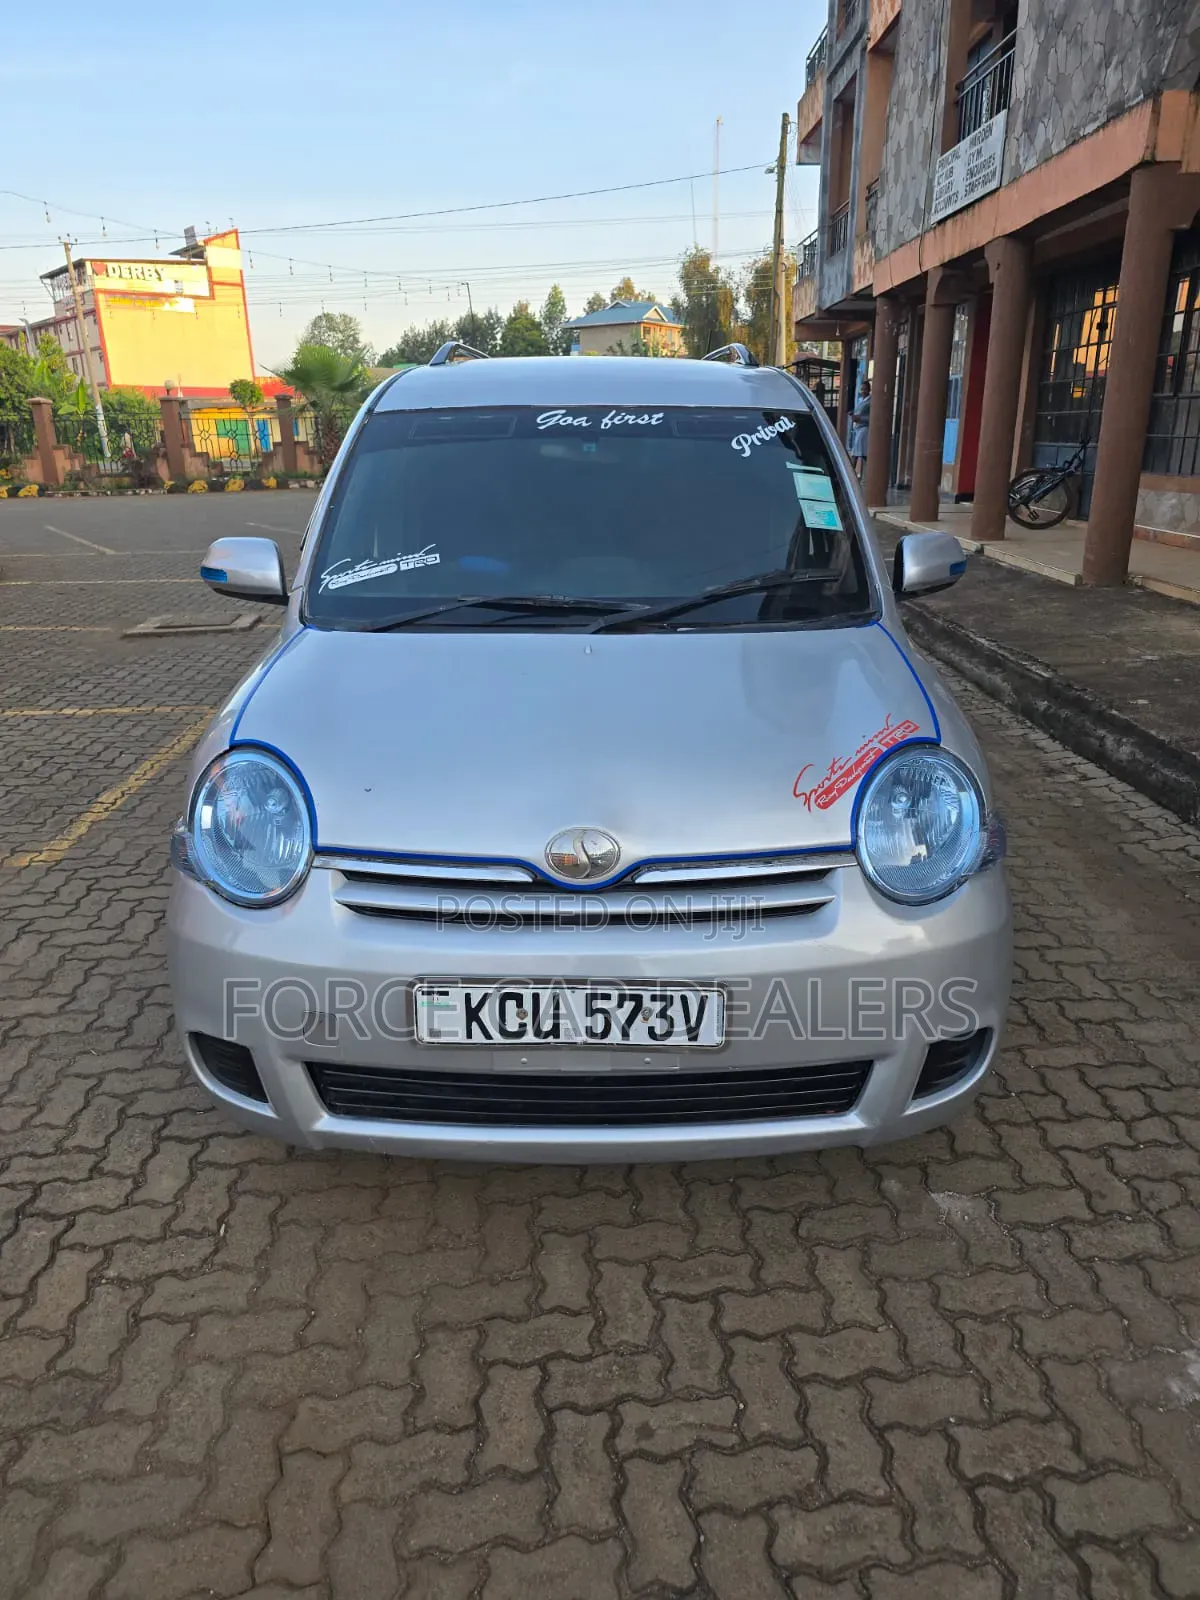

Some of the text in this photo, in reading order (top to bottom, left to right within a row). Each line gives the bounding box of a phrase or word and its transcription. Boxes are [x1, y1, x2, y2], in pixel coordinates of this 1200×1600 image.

[106, 263, 166, 281] DERBY
[600, 410, 664, 429] first
[585, 993, 708, 1042] 573V
